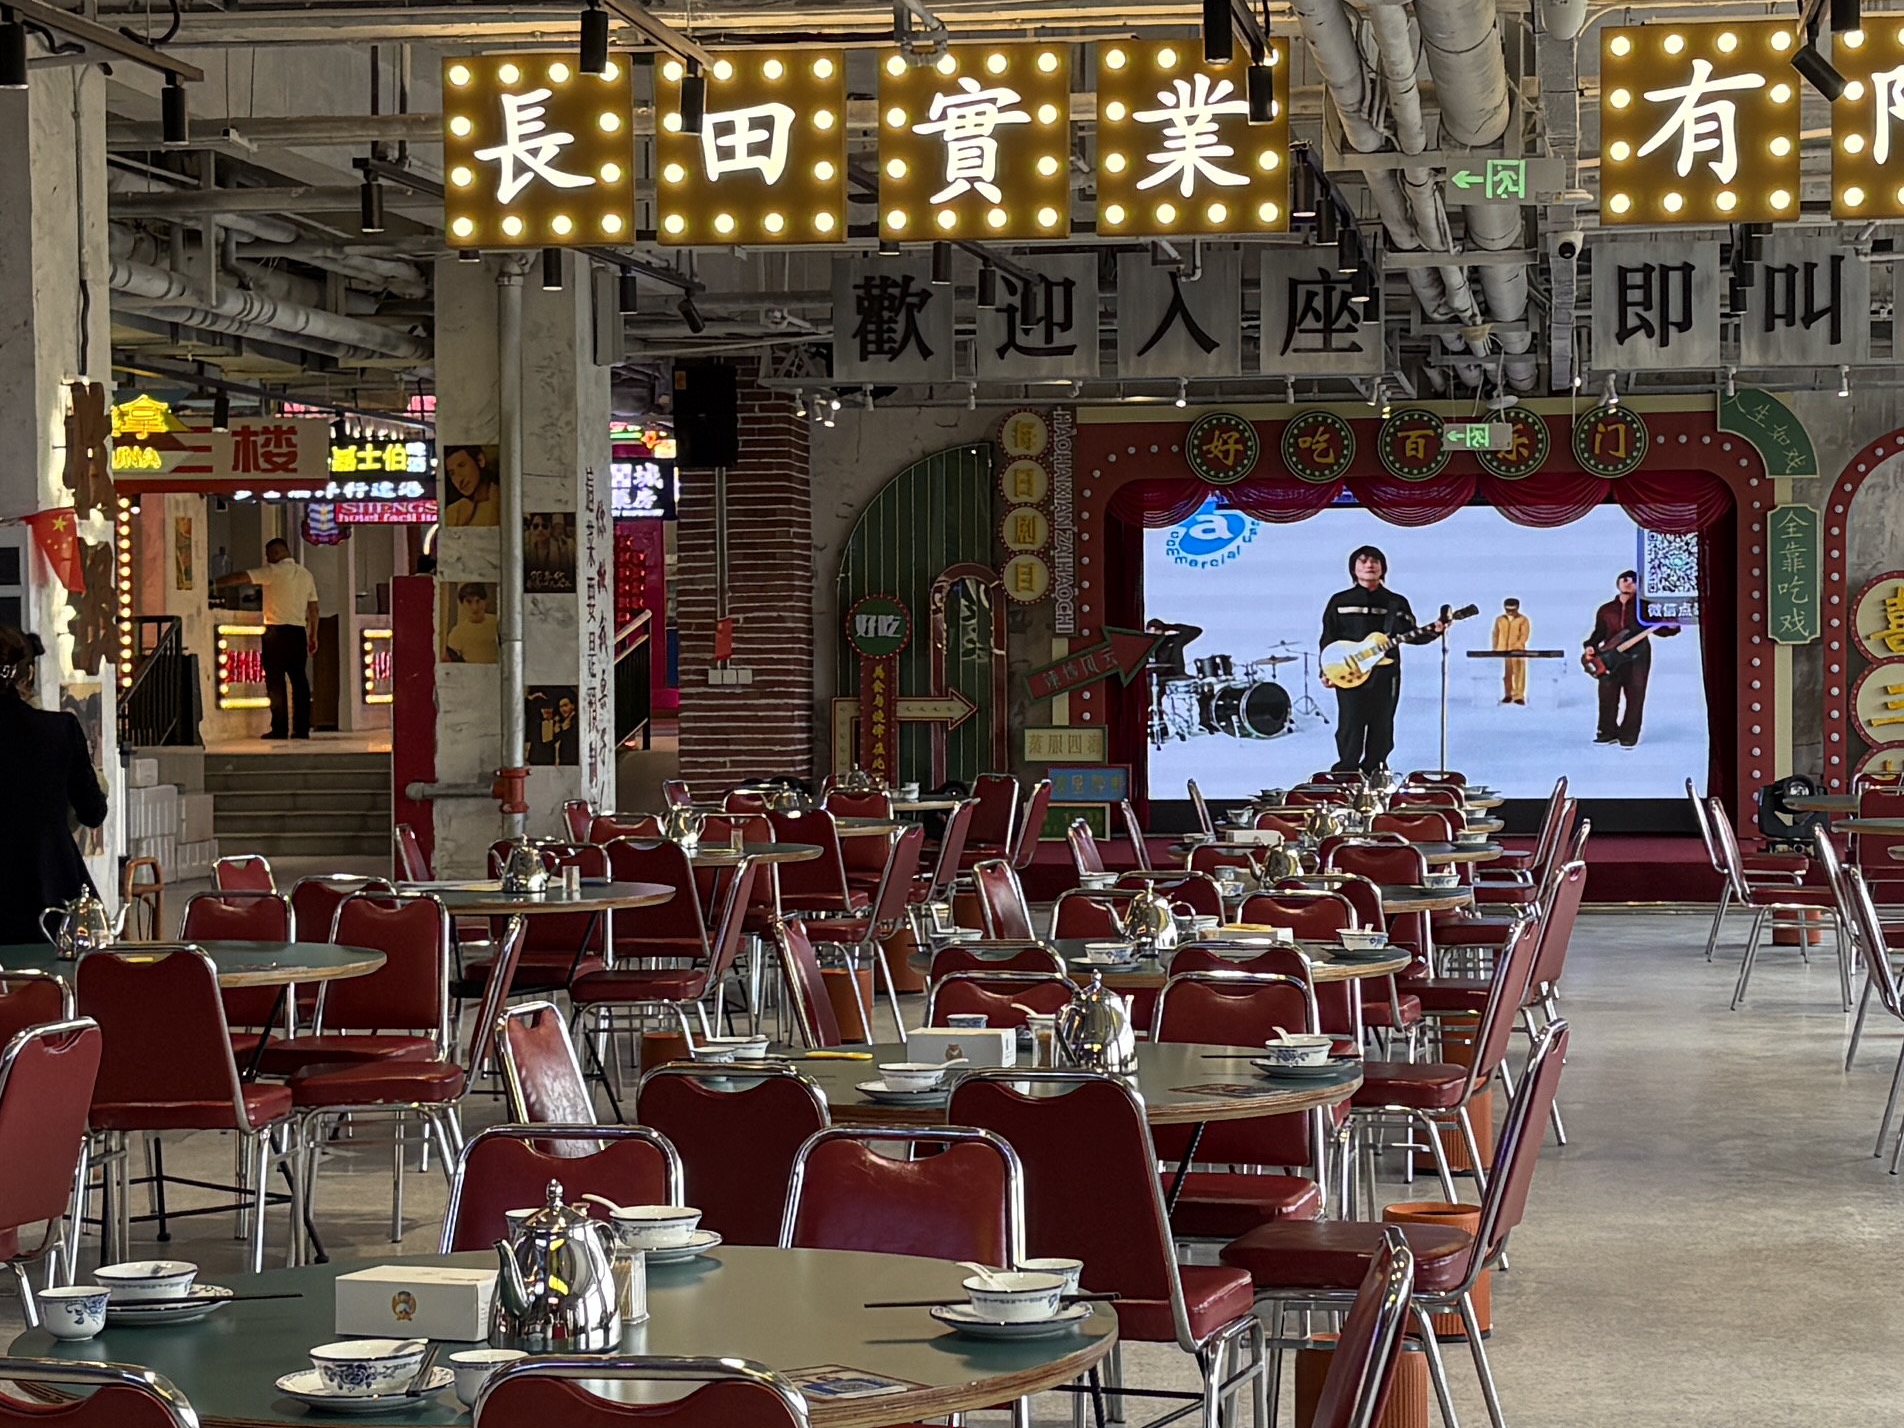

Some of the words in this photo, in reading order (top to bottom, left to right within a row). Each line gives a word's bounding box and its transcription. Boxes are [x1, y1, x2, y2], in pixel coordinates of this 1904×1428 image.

[473, 72, 1250, 207] 長田實業
[852, 270, 1368, 362] 歡迎入座
[855, 612, 902, 639] 好吃
[1777, 513, 1812, 637] 全靠吃戏
